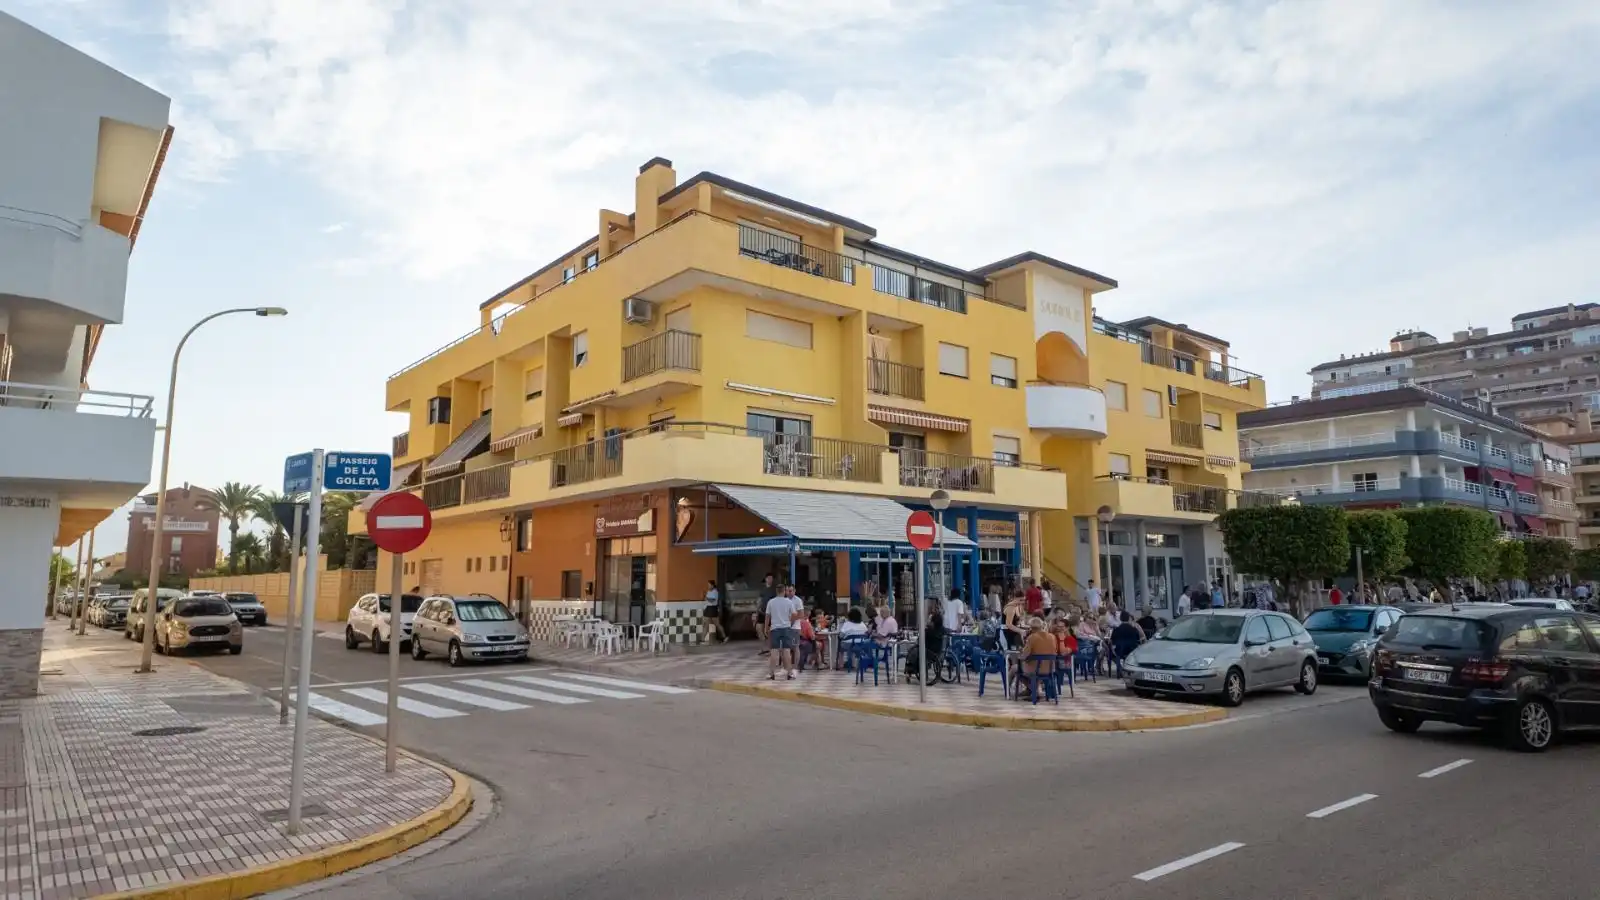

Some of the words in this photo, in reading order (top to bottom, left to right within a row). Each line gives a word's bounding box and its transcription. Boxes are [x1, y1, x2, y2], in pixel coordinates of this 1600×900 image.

[340, 457, 377, 465] PASSEIG
[344, 467, 358, 475] DE
[362, 467, 376, 475] LA
[336, 476, 379, 485] GOLETA
